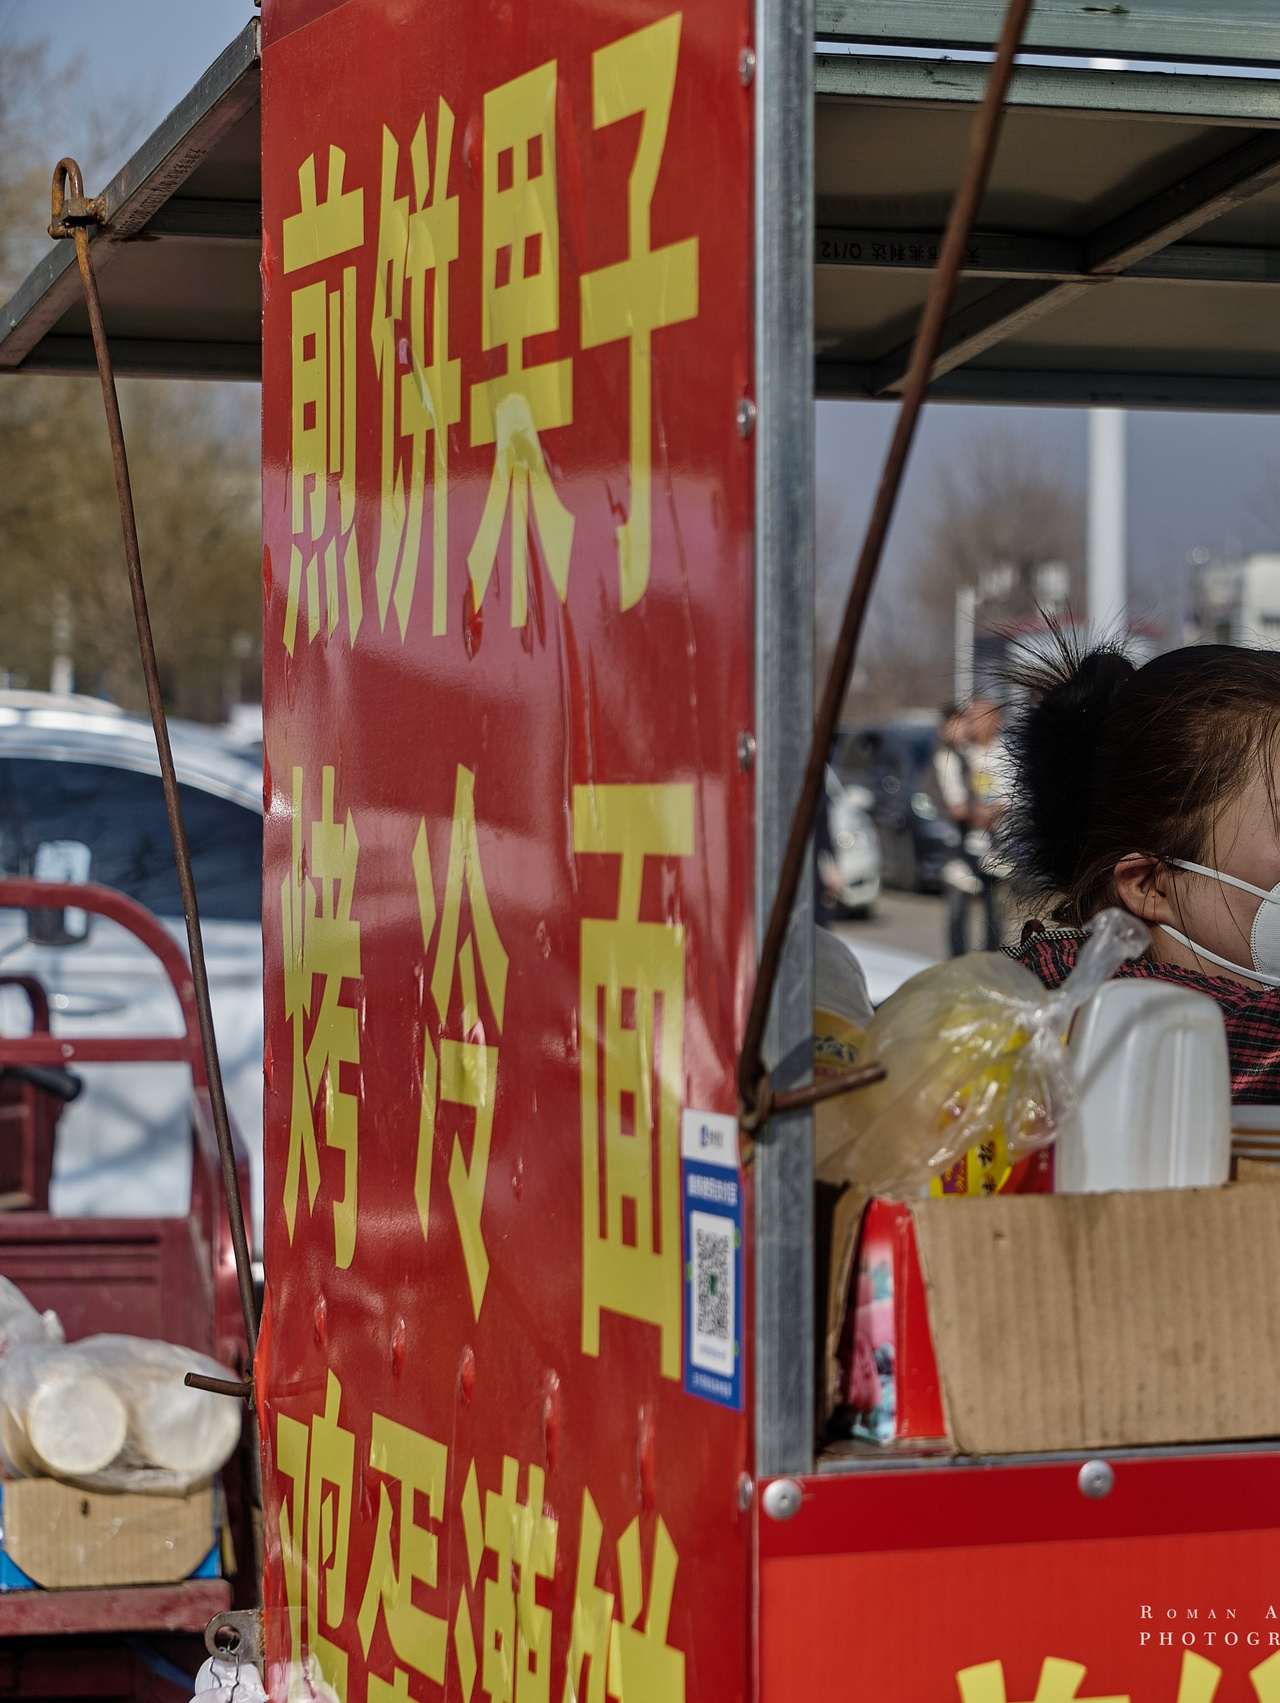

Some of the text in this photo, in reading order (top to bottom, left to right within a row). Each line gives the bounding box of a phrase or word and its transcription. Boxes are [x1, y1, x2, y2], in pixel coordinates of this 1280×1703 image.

[282, 12, 699, 658] 煎饼果子
[871, 243, 981, 263] 天市兆利达
[281, 763, 695, 1380] 烤冷面
